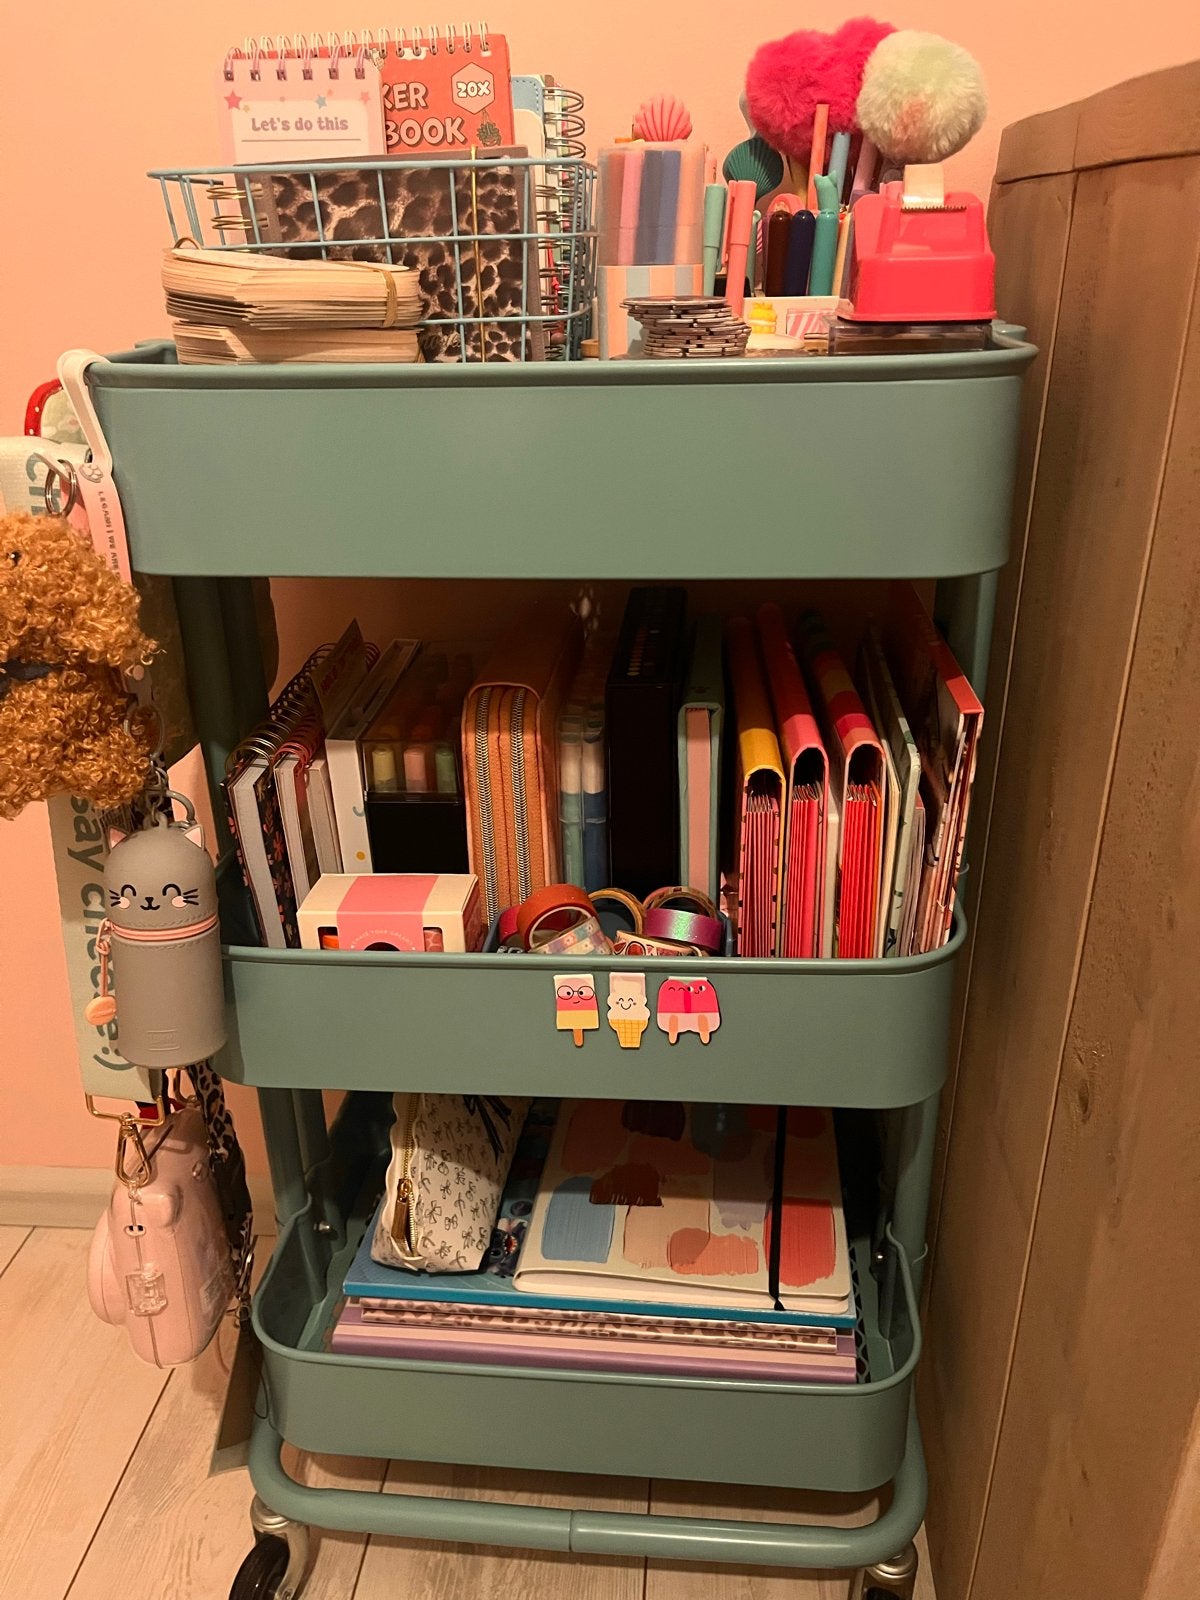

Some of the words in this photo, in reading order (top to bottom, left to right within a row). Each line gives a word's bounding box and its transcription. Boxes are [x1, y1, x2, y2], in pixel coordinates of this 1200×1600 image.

[456, 80, 491, 98] 20X
[250, 117, 291, 132] Let's
[295, 117, 314, 132] do
[317, 116, 349, 131] this
[385, 116, 468, 148] BOOK
[98, 490, 112, 529] LEGAMI
[108, 535, 116, 550] WE
